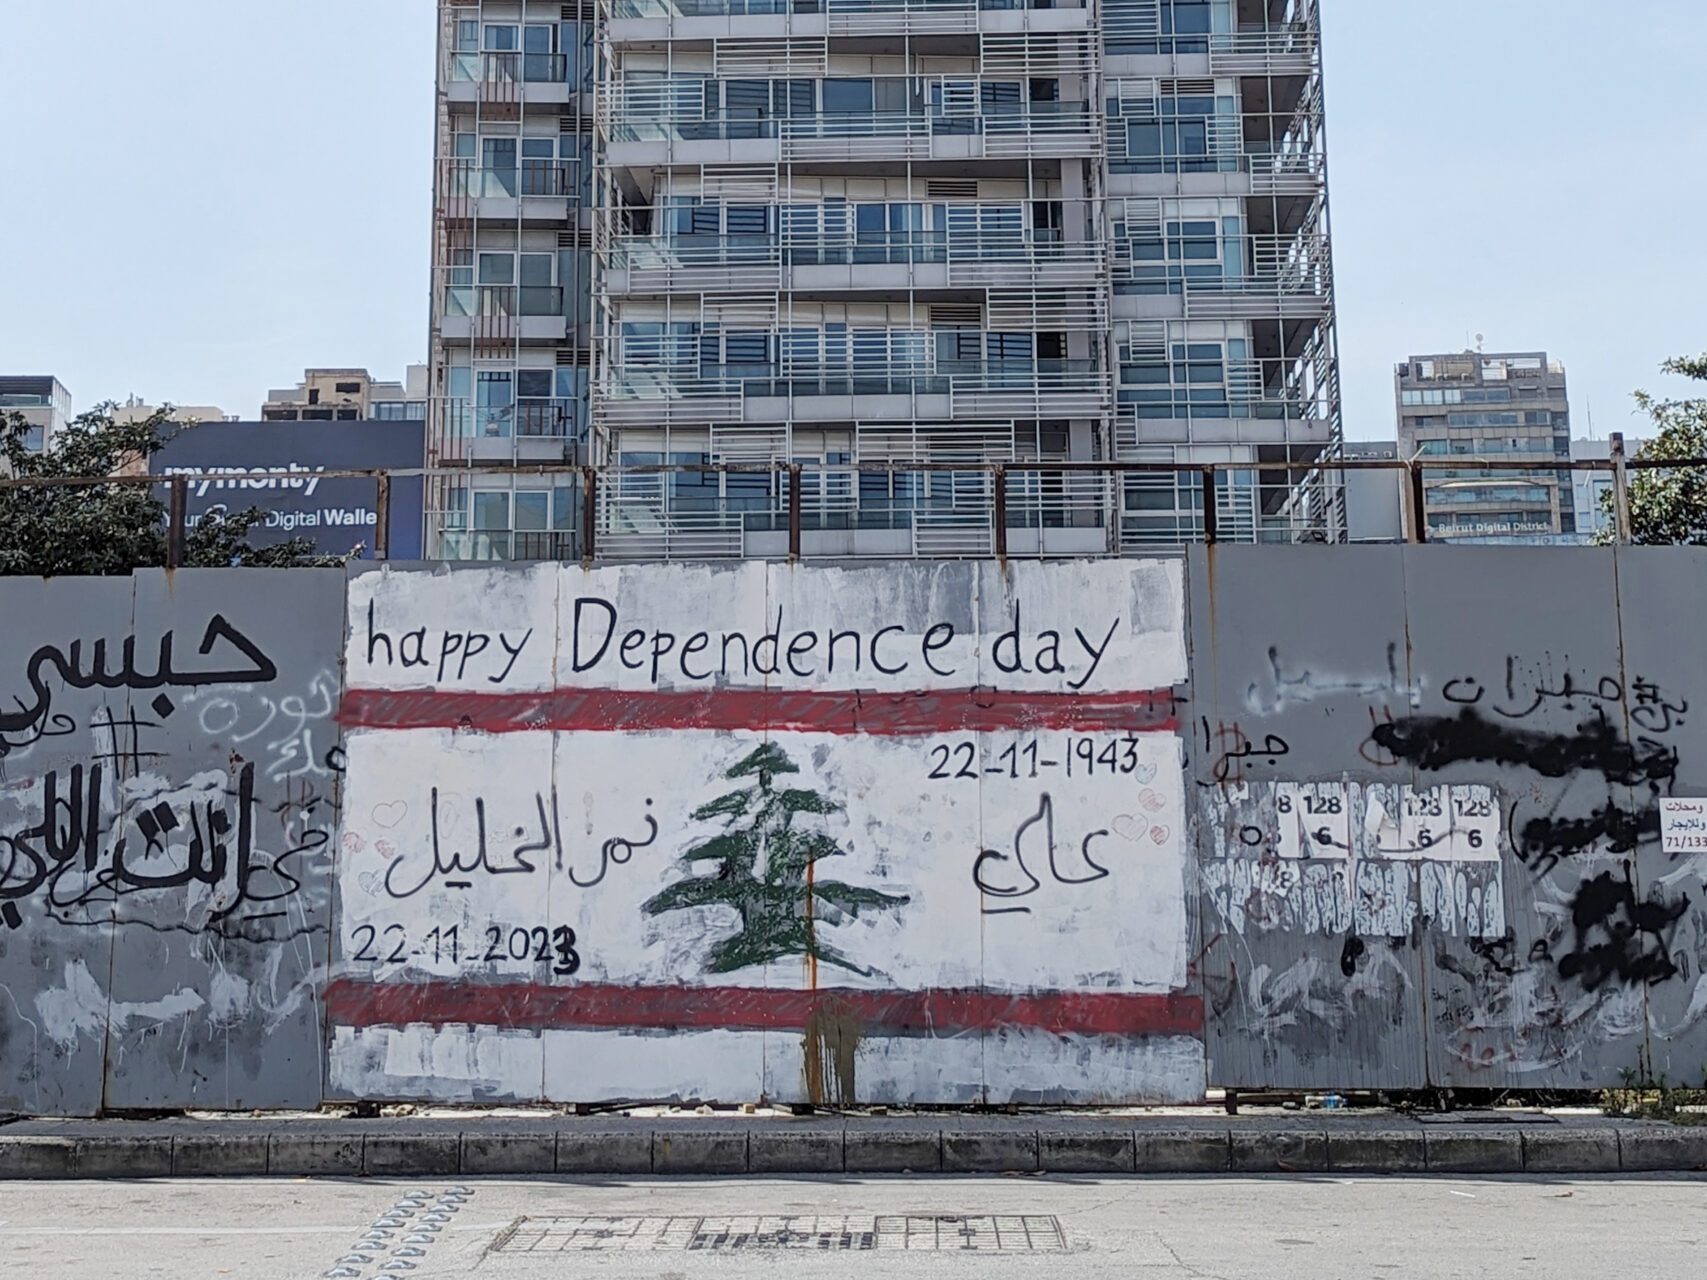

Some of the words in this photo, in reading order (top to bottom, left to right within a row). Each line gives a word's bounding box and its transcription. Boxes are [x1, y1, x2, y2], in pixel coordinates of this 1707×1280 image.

[164, 463, 324, 496] mymonty
[162, 509, 202, 527] Yur
[266, 509, 321, 531] Digital
[324, 508, 378, 525] Walle
[1438, 523, 1474, 534] Beirut
[1476, 522, 1511, 535] Digital
[1513, 521, 1549, 532] District
[367, 596, 533, 683] happy
[571, 597, 957, 684] Dependence
[992, 597, 1120, 690] day
[927, 736, 1140, 780] 22-11-1943
[1302, 794, 1343, 815] 128
[1404, 796, 1443, 818] 128
[1454, 796, 1493, 818] 128
[1665, 802, 1704, 814] ومحلات
[385, 783, 563, 899] الخليل
[1316, 825, 1333, 846] 6
[1417, 827, 1434, 849] 6
[1467, 828, 1483, 849] 6
